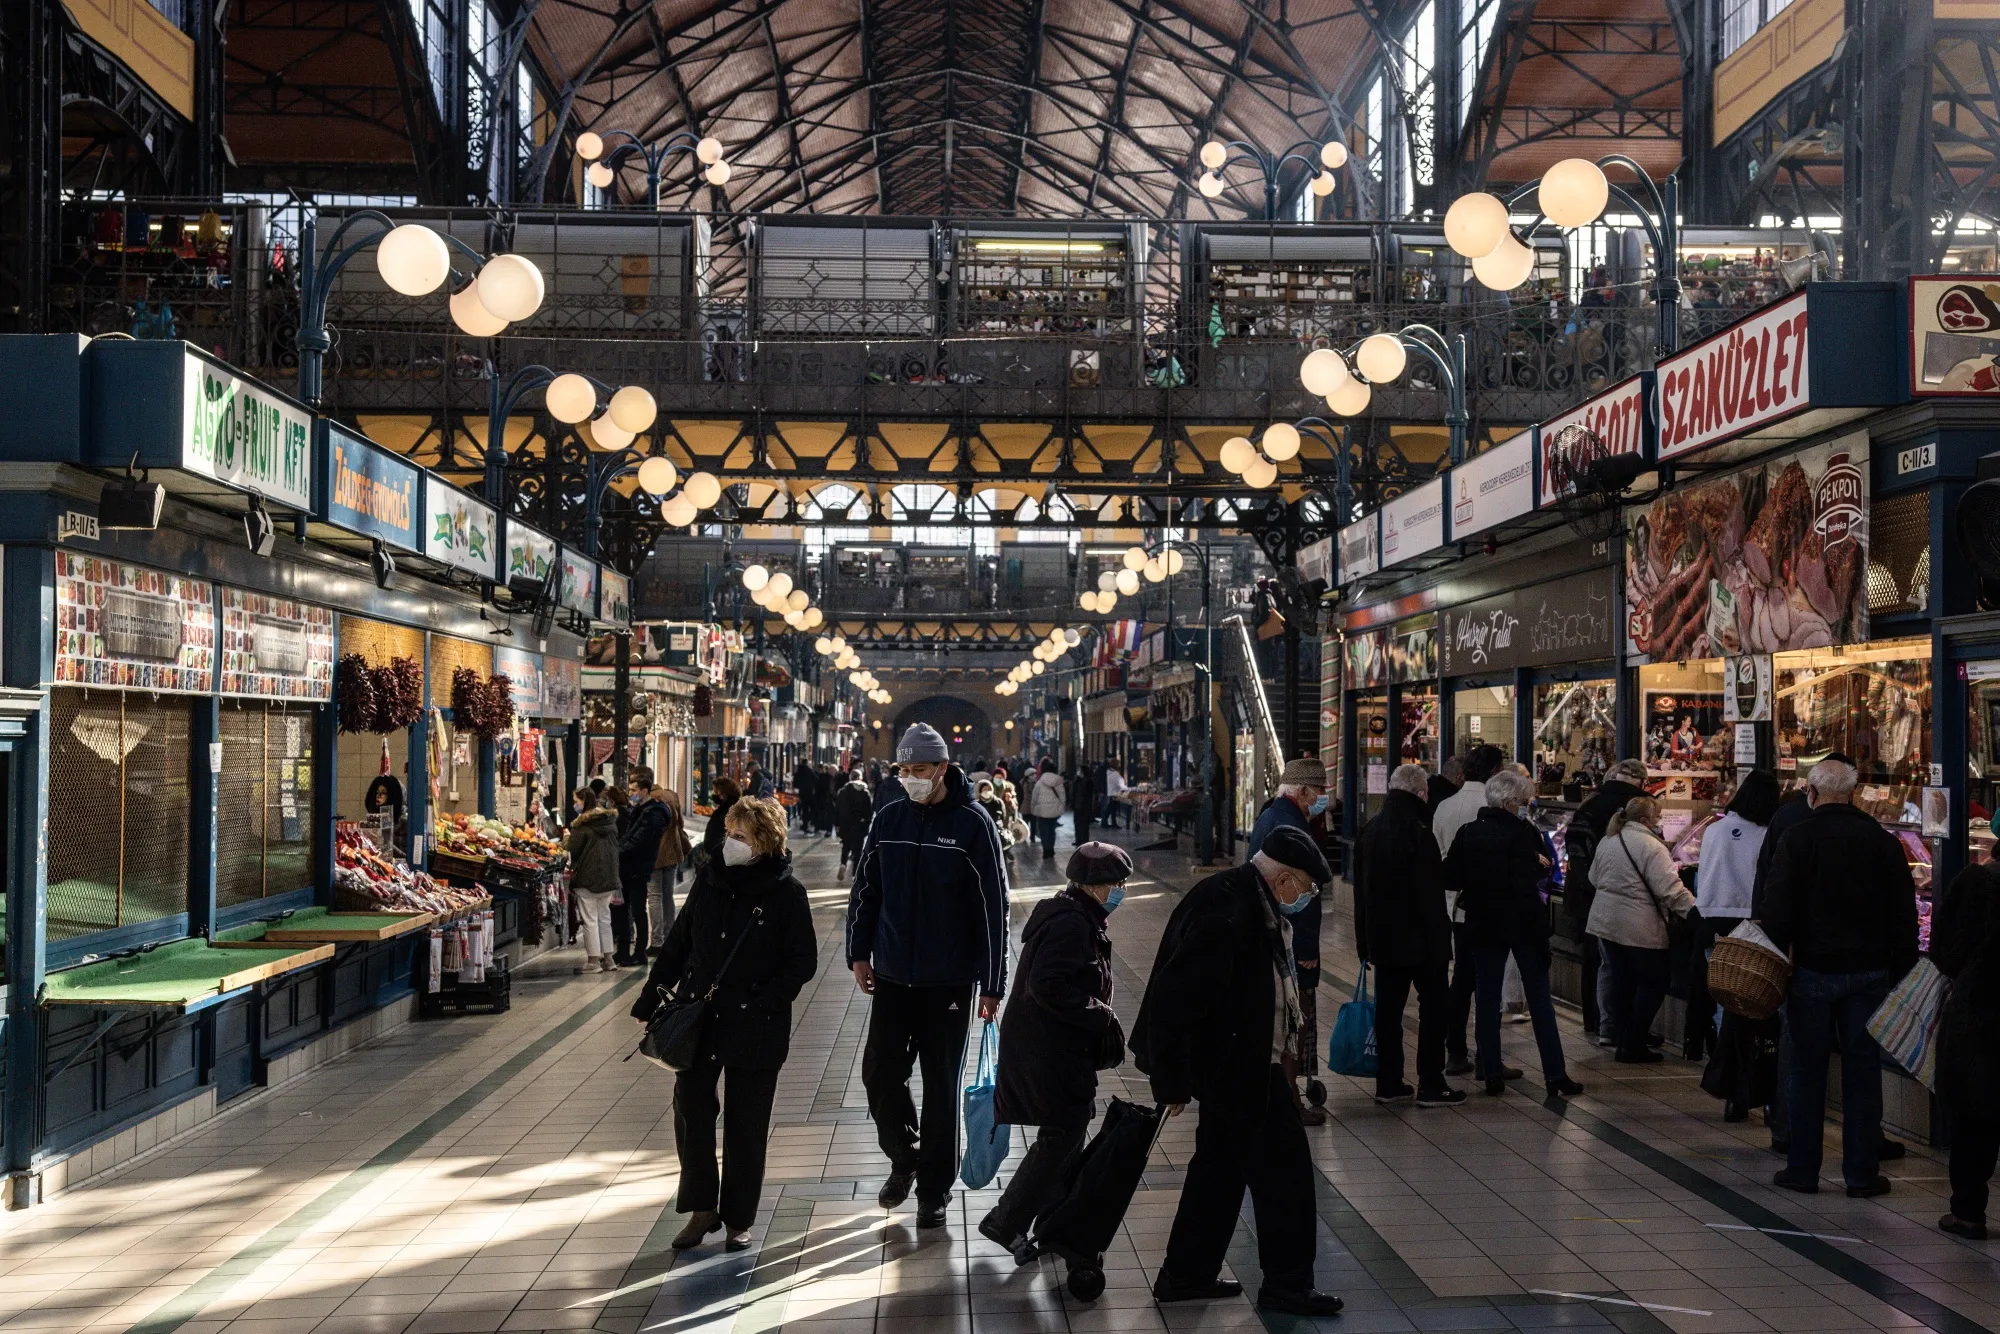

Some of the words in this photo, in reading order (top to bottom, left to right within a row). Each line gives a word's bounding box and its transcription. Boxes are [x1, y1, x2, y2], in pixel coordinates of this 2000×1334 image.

[1662, 311, 1808, 450] SZAKÜZLET
[192, 371, 280, 484] AGRO-FRUIT
[284, 416, 307, 498] KFT.
[1902, 446, 1932, 471] C-II/3.
[1820, 478, 1858, 509] PEKPOL
[937, 836, 957, 845] NIKE
[1363, 1045, 1379, 1056] AL
